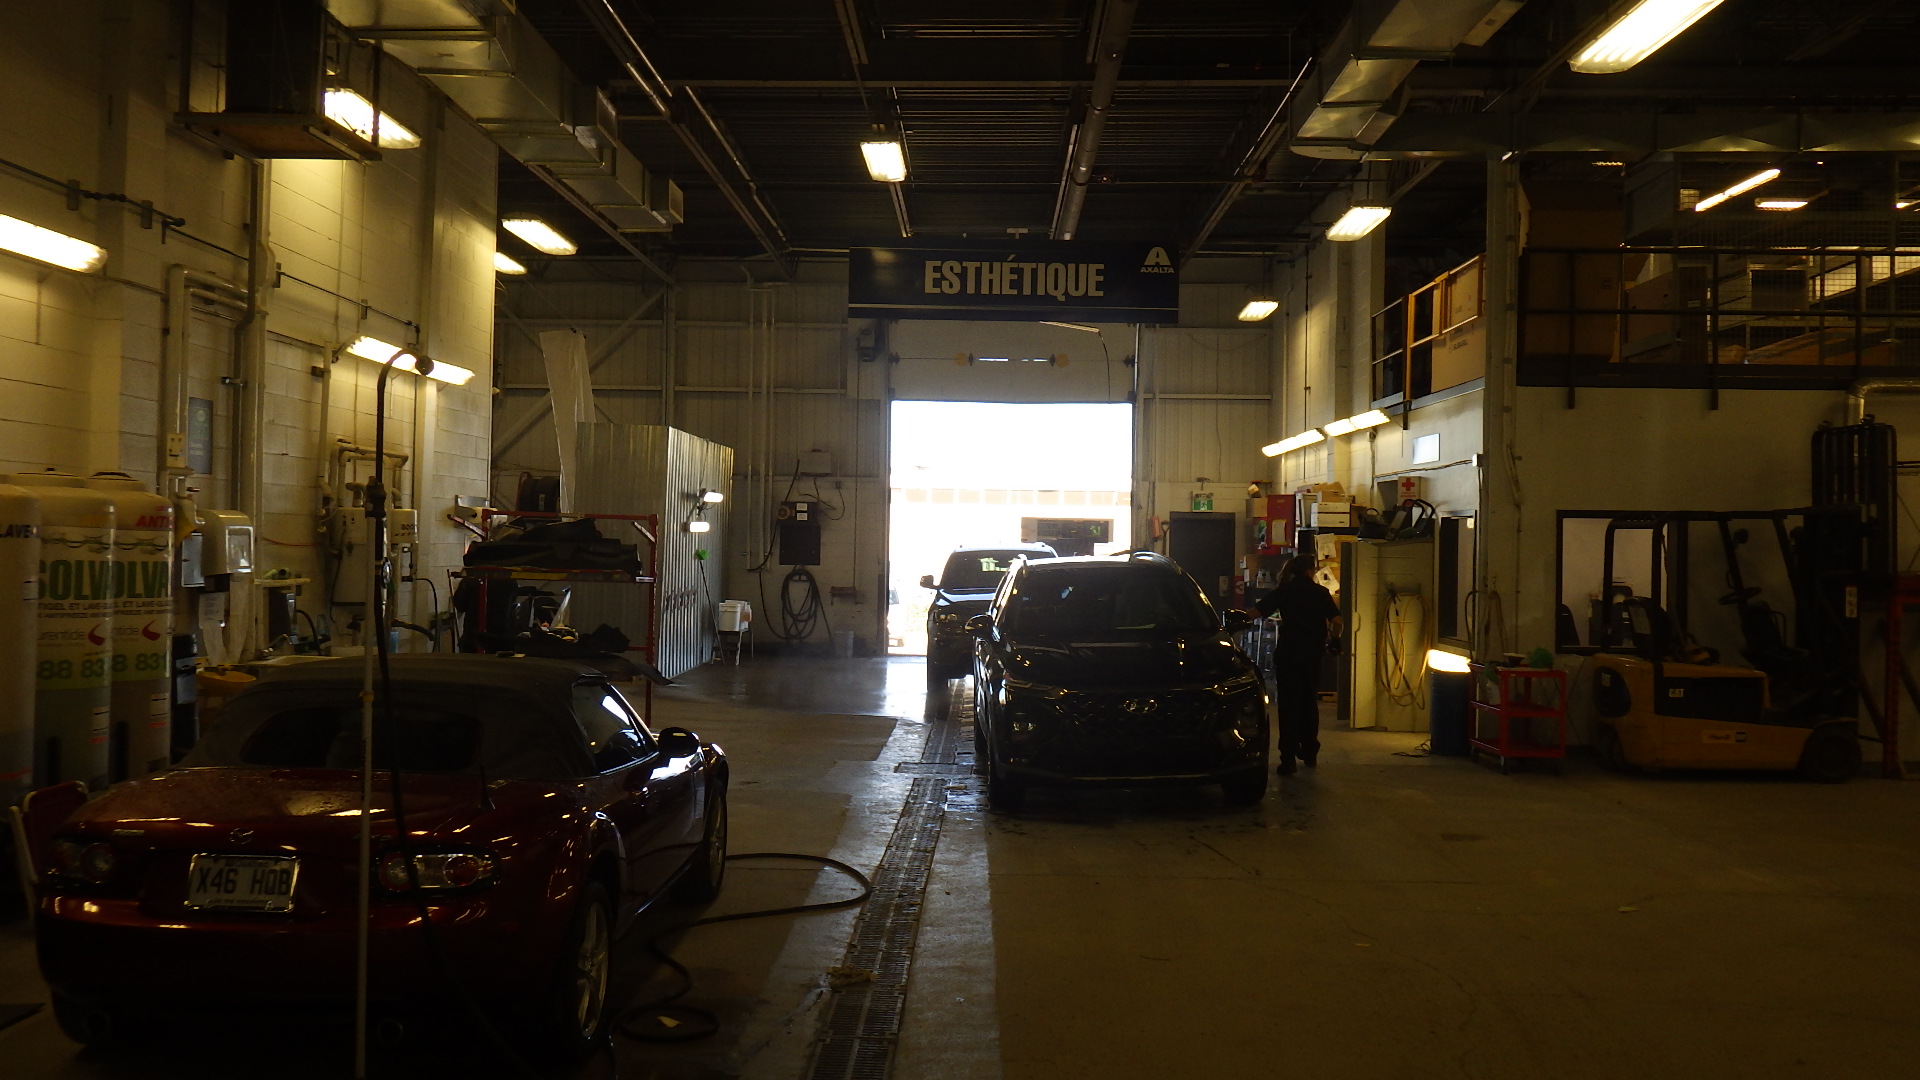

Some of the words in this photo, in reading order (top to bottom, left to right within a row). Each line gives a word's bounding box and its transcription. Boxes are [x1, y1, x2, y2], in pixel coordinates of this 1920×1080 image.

[924, 254, 1105, 302] ESTHÉTIQUE
[1140, 266, 1175, 274] AXALTA
[1668, 687, 1686, 698] CAT
[196, 867, 239, 895] X46
